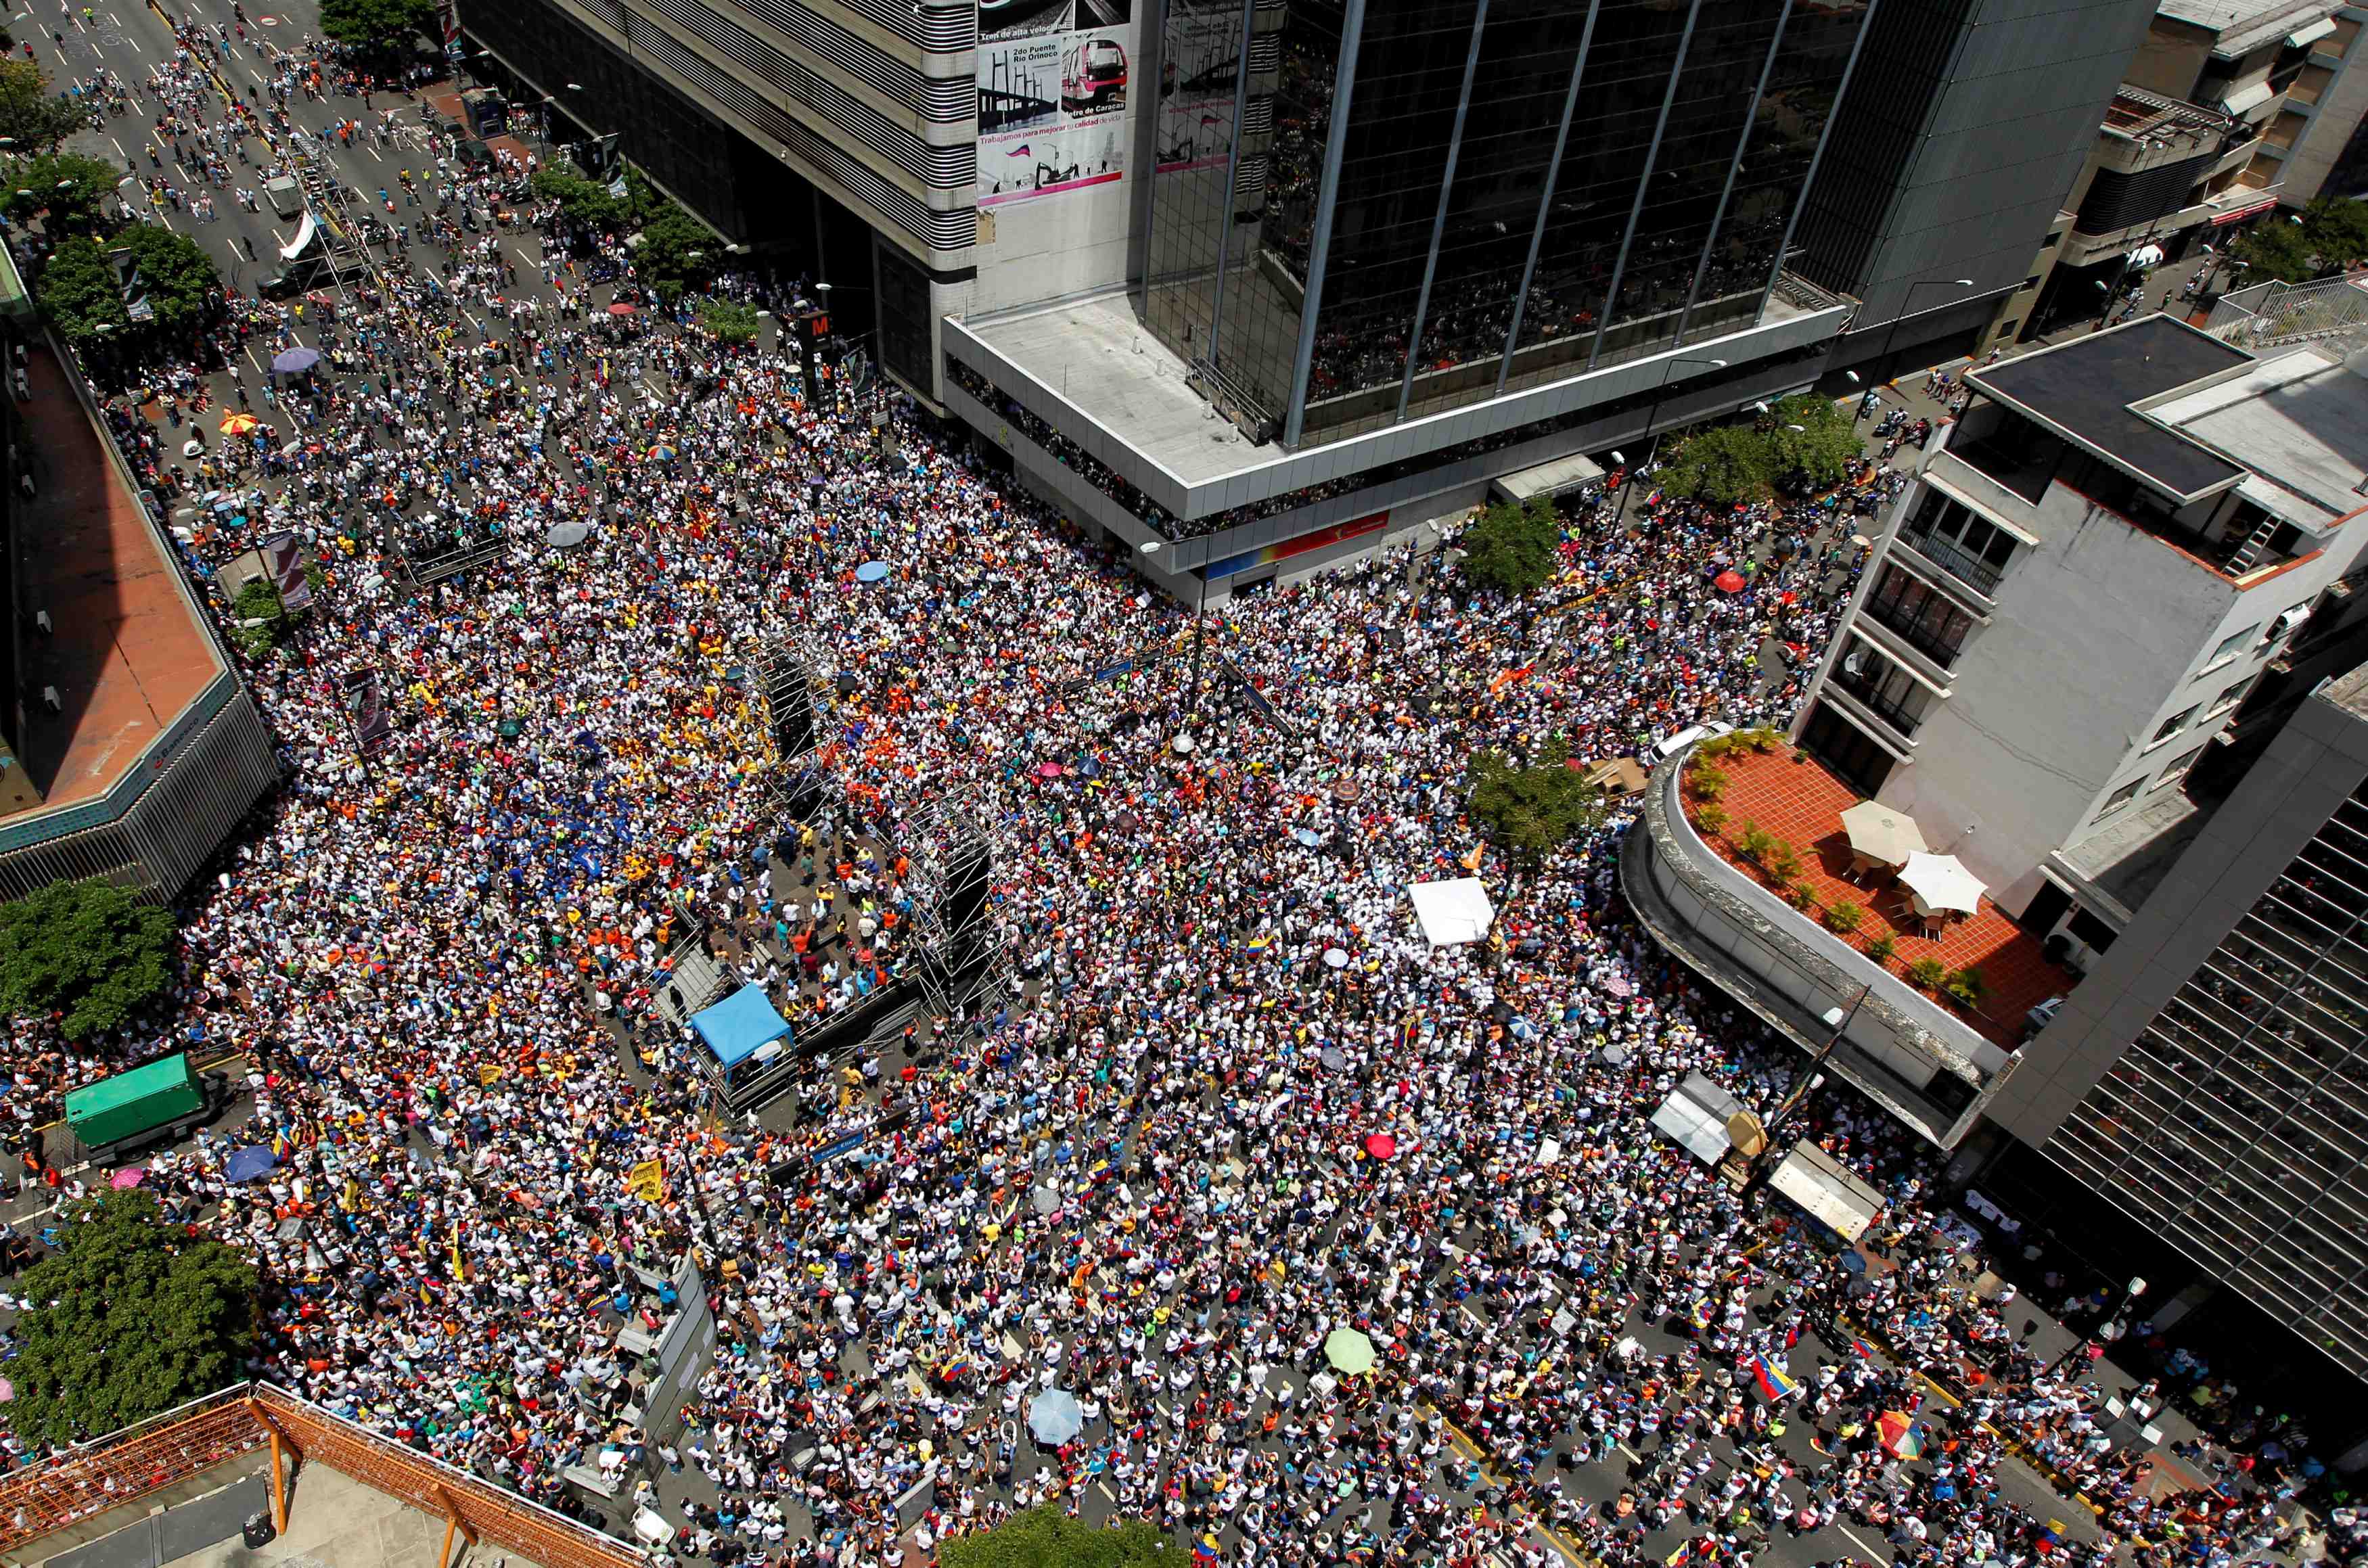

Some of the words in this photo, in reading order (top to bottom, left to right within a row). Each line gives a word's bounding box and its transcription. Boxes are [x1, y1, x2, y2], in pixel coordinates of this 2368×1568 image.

[1012, 28, 1028, 37] alta
[1029, 43, 1056, 53] Puente
[1028, 51, 1058, 61] Orinoco
[1064, 110, 1084, 118] etro
[1095, 103, 1124, 112] Caracas
[980, 133, 1022, 144] Trabajamos
[1022, 129, 1039, 139] para
[1039, 124, 1066, 135] mejorar
[1074, 117, 1099, 128] calidad
[812, 315, 828, 336] M
[161, 718, 199, 758] Banesco
[821, 1147, 838, 1156] Calle
